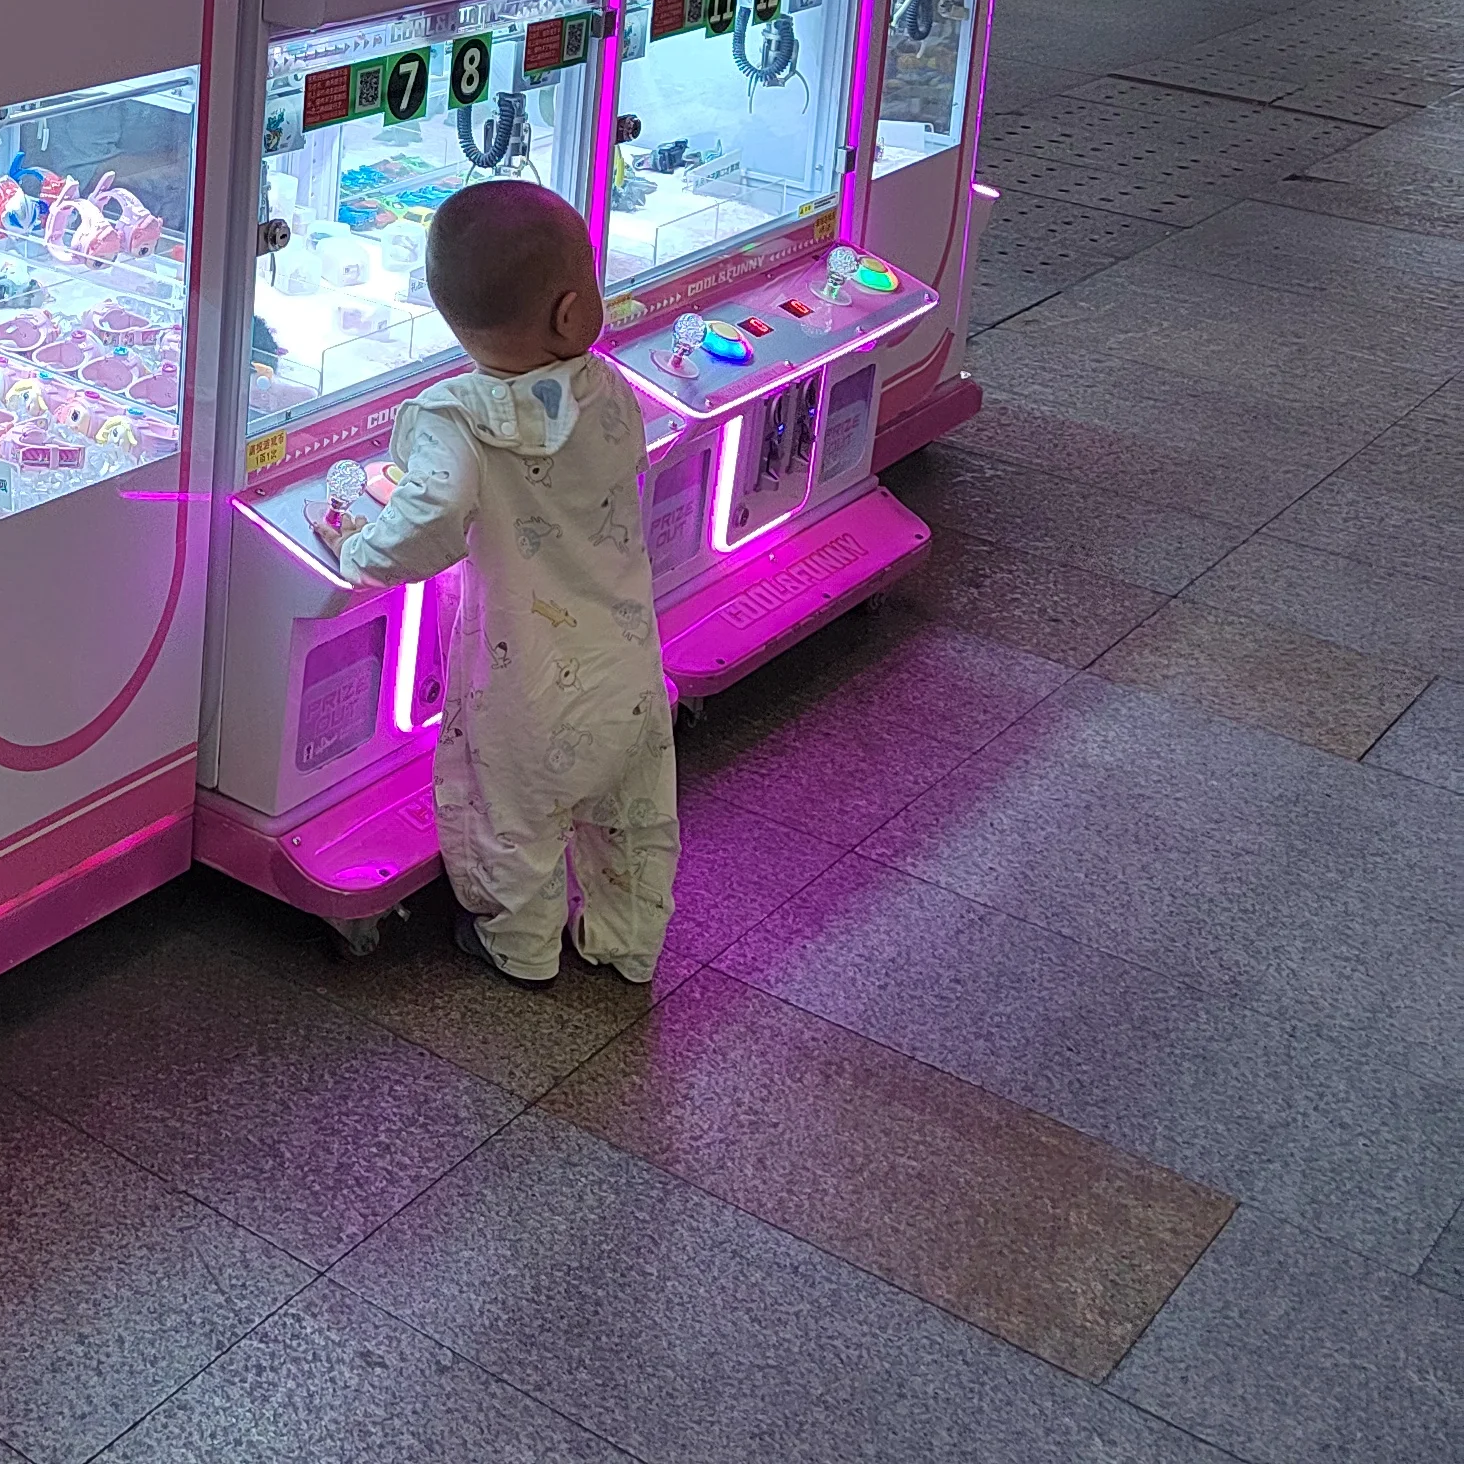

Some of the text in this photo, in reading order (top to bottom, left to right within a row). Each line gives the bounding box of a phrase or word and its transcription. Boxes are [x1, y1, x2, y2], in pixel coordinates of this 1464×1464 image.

[399, 59, 420, 112] 7
[461, 47, 482, 95] 8
[687, 254, 766, 298] COOL&FUNNY
[651, 502, 694, 534] PRIZE
